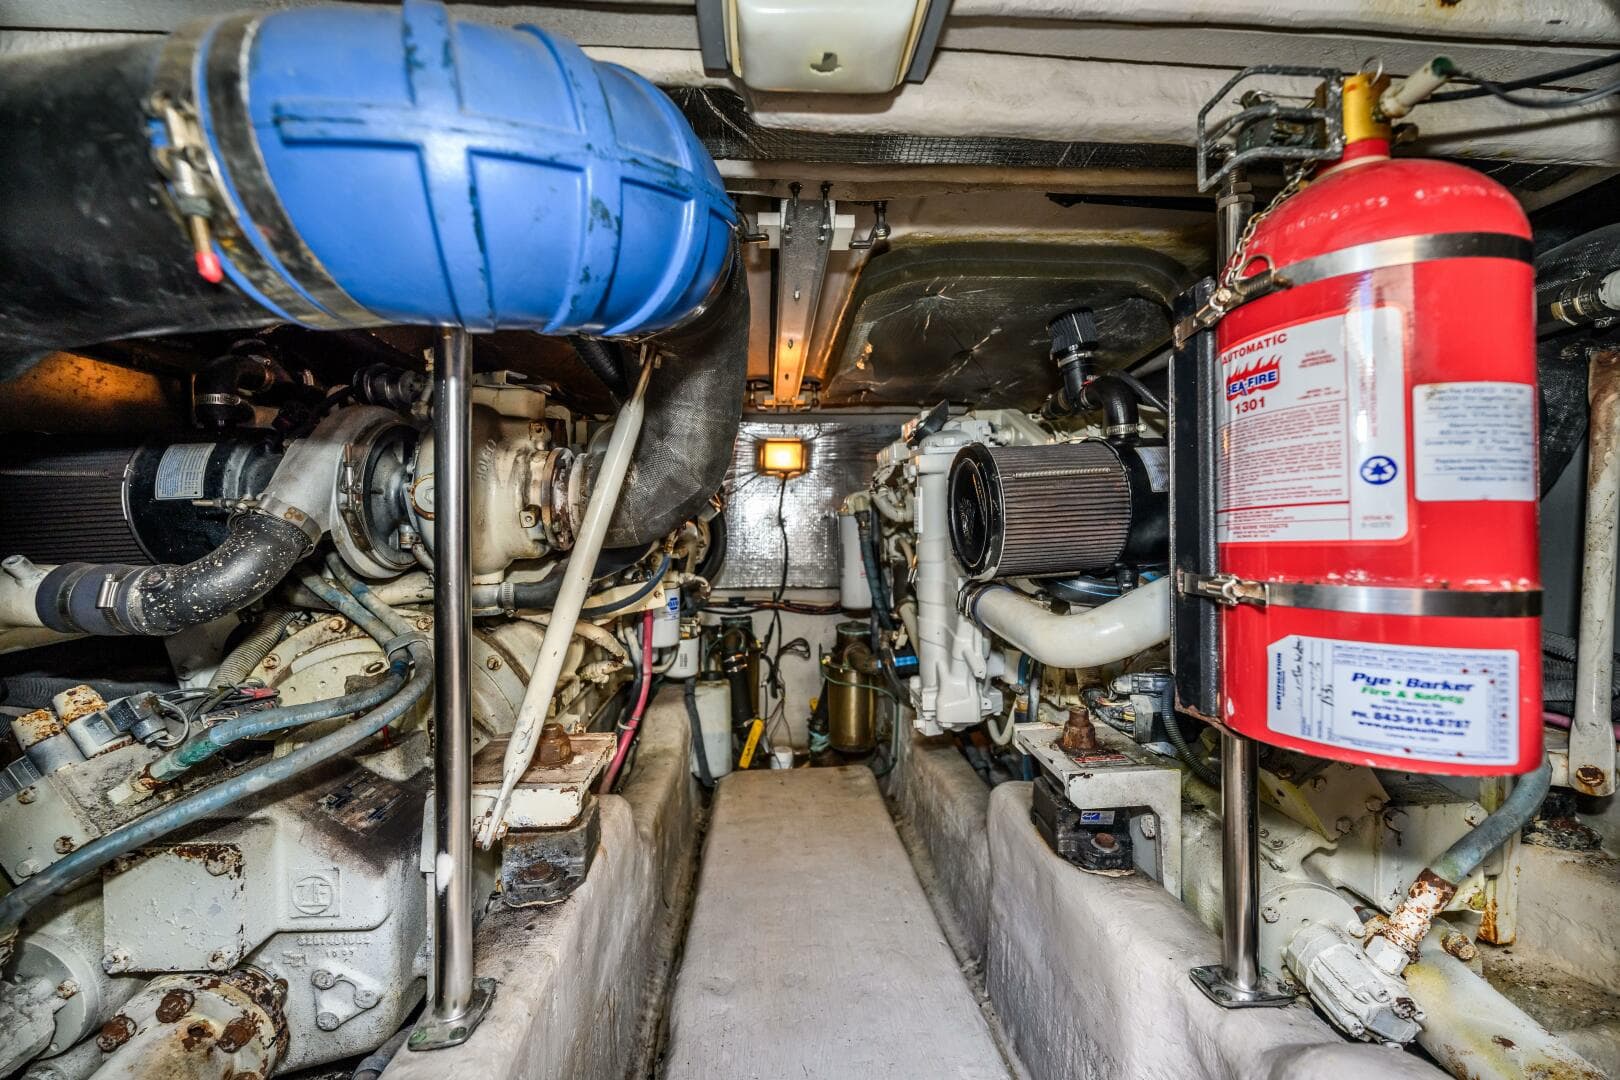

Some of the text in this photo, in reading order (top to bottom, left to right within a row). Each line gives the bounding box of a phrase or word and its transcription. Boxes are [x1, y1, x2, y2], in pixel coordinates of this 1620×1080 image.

[1222, 333, 1288, 365] AUTOMATIC
[1235, 396, 1265, 414] 1301
[1352, 672, 1474, 692] Pye Barker
[1361, 686, 1391, 697] Fire
[1414, 692, 1465, 705] Safety
